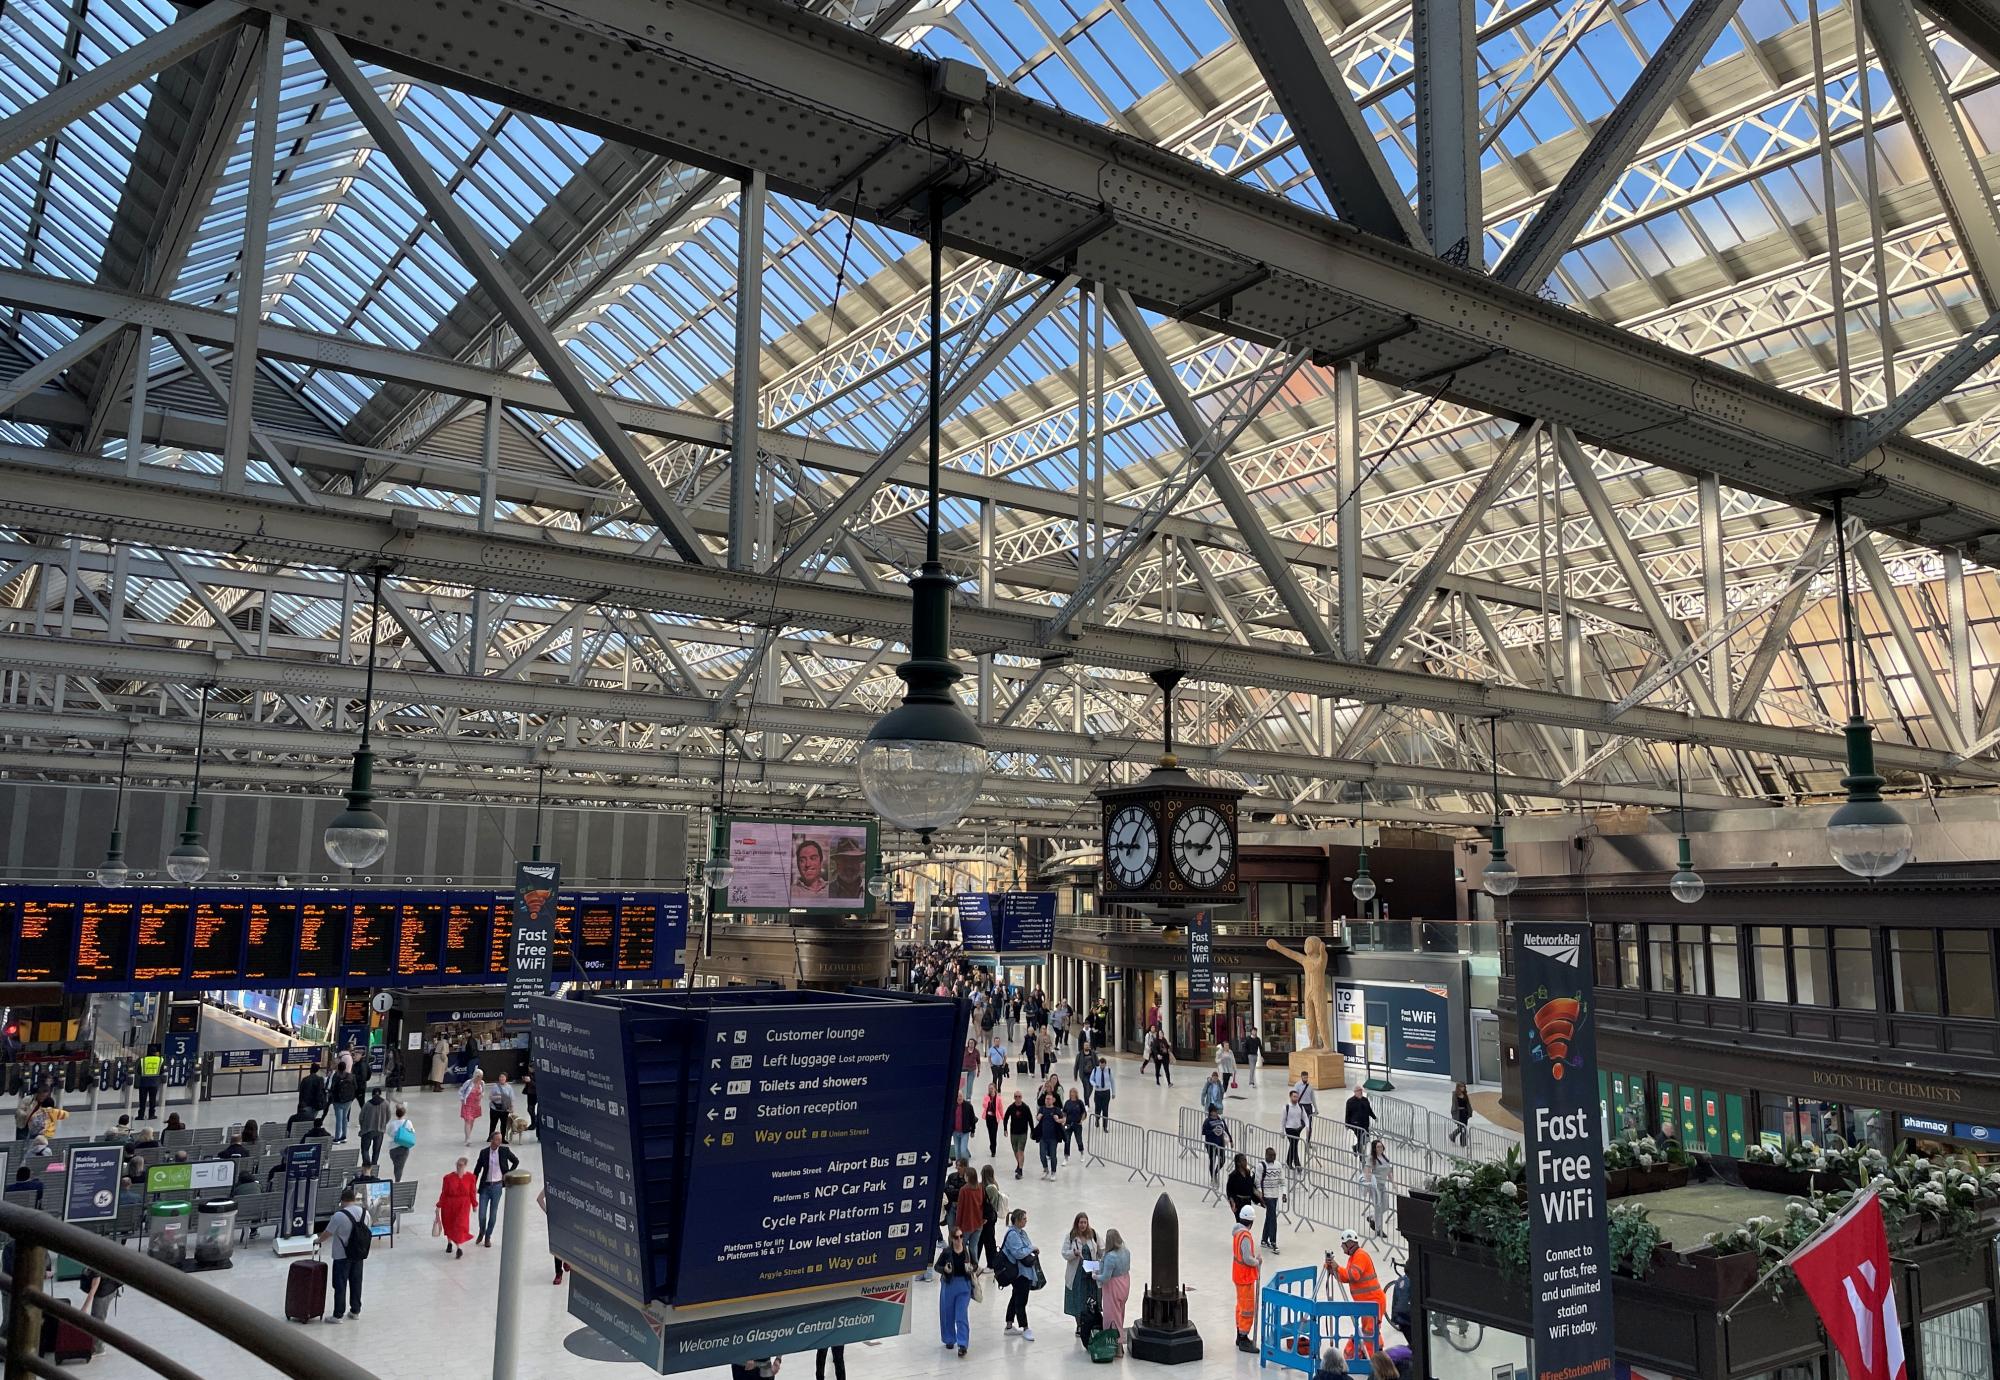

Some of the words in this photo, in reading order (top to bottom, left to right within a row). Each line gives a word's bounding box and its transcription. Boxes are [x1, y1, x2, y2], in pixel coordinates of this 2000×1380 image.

[518, 928, 547, 941] Fast
[1191, 932, 1208, 942] Fast
[1524, 933, 1580, 946] NetworkRail
[516, 943, 547, 956] Free
[1191, 943, 1208, 953] Free
[517, 957, 545, 970] WiFi
[1192, 954, 1209, 963] WiFi
[1337, 991, 1352, 1001] TO
[463, 1011, 503, 1019] Information
[1337, 1003, 1356, 1013] LET
[547, 1018, 556, 1028] Left
[556, 1019, 572, 1033] luggage
[1412, 1010, 1436, 1024] WiFi
[348, 1033, 357, 1045] 4
[766, 1028, 823, 1042] Customer
[827, 1027, 865, 1040] lounge
[176, 1041, 185, 1054] 3
[546, 1039, 558, 1053] Cycle
[558, 1041, 568, 1054] Park
[568, 1045, 588, 1058] Platform
[588, 1049, 595, 1060] 15
[763, 1054, 787, 1067] Left
[790, 1053, 836, 1067] luggage
[839, 1054, 855, 1062] Lost
[857, 1052, 890, 1063] property
[551, 1062, 559, 1073] Low
[570, 1069, 586, 1080] station
[759, 1079, 795, 1092] Toilets
[799, 1077, 819, 1089] and
[822, 1075, 868, 1088] showers
[1813, 1071, 1853, 1087] BOOTS
[1856, 1077, 1885, 1092] THE
[1889, 1080, 1960, 1101] CHEMISTS
[580, 1094, 596, 1108] Airport
[597, 1099, 606, 1111] Bus
[757, 1103, 800, 1118] Station
[803, 1100, 857, 1116] reception
[1535, 1107, 1589, 1142] Fast
[1904, 1117, 1948, 1133] pharmacy
[755, 1129, 782, 1145] Way
[785, 1128, 806, 1140] out
[829, 1130, 848, 1138] Union
[849, 1128, 869, 1137] Street
[556, 1141, 572, 1157] Tickets
[573, 1149, 581, 1162] and
[581, 1151, 594, 1167] Travel
[595, 1157, 611, 1173] Centre
[772, 1169, 800, 1179] Waterloo
[803, 1167, 822, 1176] Street
[828, 1158, 867, 1173] Airport
[870, 1156, 889, 1168] Bus
[1538, 1150, 1591, 1184] Free
[595, 1181, 613, 1199] Tickets
[773, 1193, 801, 1202] Platform
[815, 1185, 838, 1198] NCP
[842, 1183, 859, 1195] Car
[863, 1180, 886, 1192] Park
[558, 1189, 566, 1200] and
[585, 1199, 602, 1218] Station
[603, 1208, 613, 1223] Link
[1540, 1188, 1593, 1225] WiFi
[762, 1215, 796, 1231] Cycle
[800, 1211, 825, 1224] Park
[829, 1206, 879, 1220] Platform
[882, 1203, 894, 1214] 15
[724, 1243, 753, 1252] Platform
[763, 1240, 773, 1248] for
[775, 1238, 784, 1246] lift
[789, 1237, 812, 1250] Low
[816, 1233, 841, 1247] level
[844, 1230, 881, 1244] station
[727, 1250, 759, 1260] Platforms
[1546, 1246, 1582, 1263] Connect
[1583, 1245, 1593, 1256] to
[759, 1270, 783, 1280] Argyle
[784, 1267, 804, 1276] Street
[828, 1256, 854, 1271] Way
[857, 1253, 877, 1264] out
[1543, 1270, 1558, 1282] our
[1560, 1266, 1579, 1280] fast,
[1580, 1263, 1597, 1275] free
[861, 1281, 909, 1294] NetworkRail
[1542, 1288, 1559, 1302] and
[1561, 1279, 1601, 1298] unlimited
[1557, 1303, 1587, 1319] station
[613, 1314, 629, 1333] Central
[631, 1324, 647, 1344] Station
[679, 1334, 729, 1354] Welcome
[732, 1334, 743, 1345] to
[746, 1326, 793, 1344] Glasgow
[796, 1319, 835, 1334] Central
[837, 1312, 875, 1328] Station
[1549, 1324, 1570, 1340] WiFi
[1571, 1320, 1598, 1336] today.
[1539, 1358, 1611, 1380] #FreeStationWiFi
